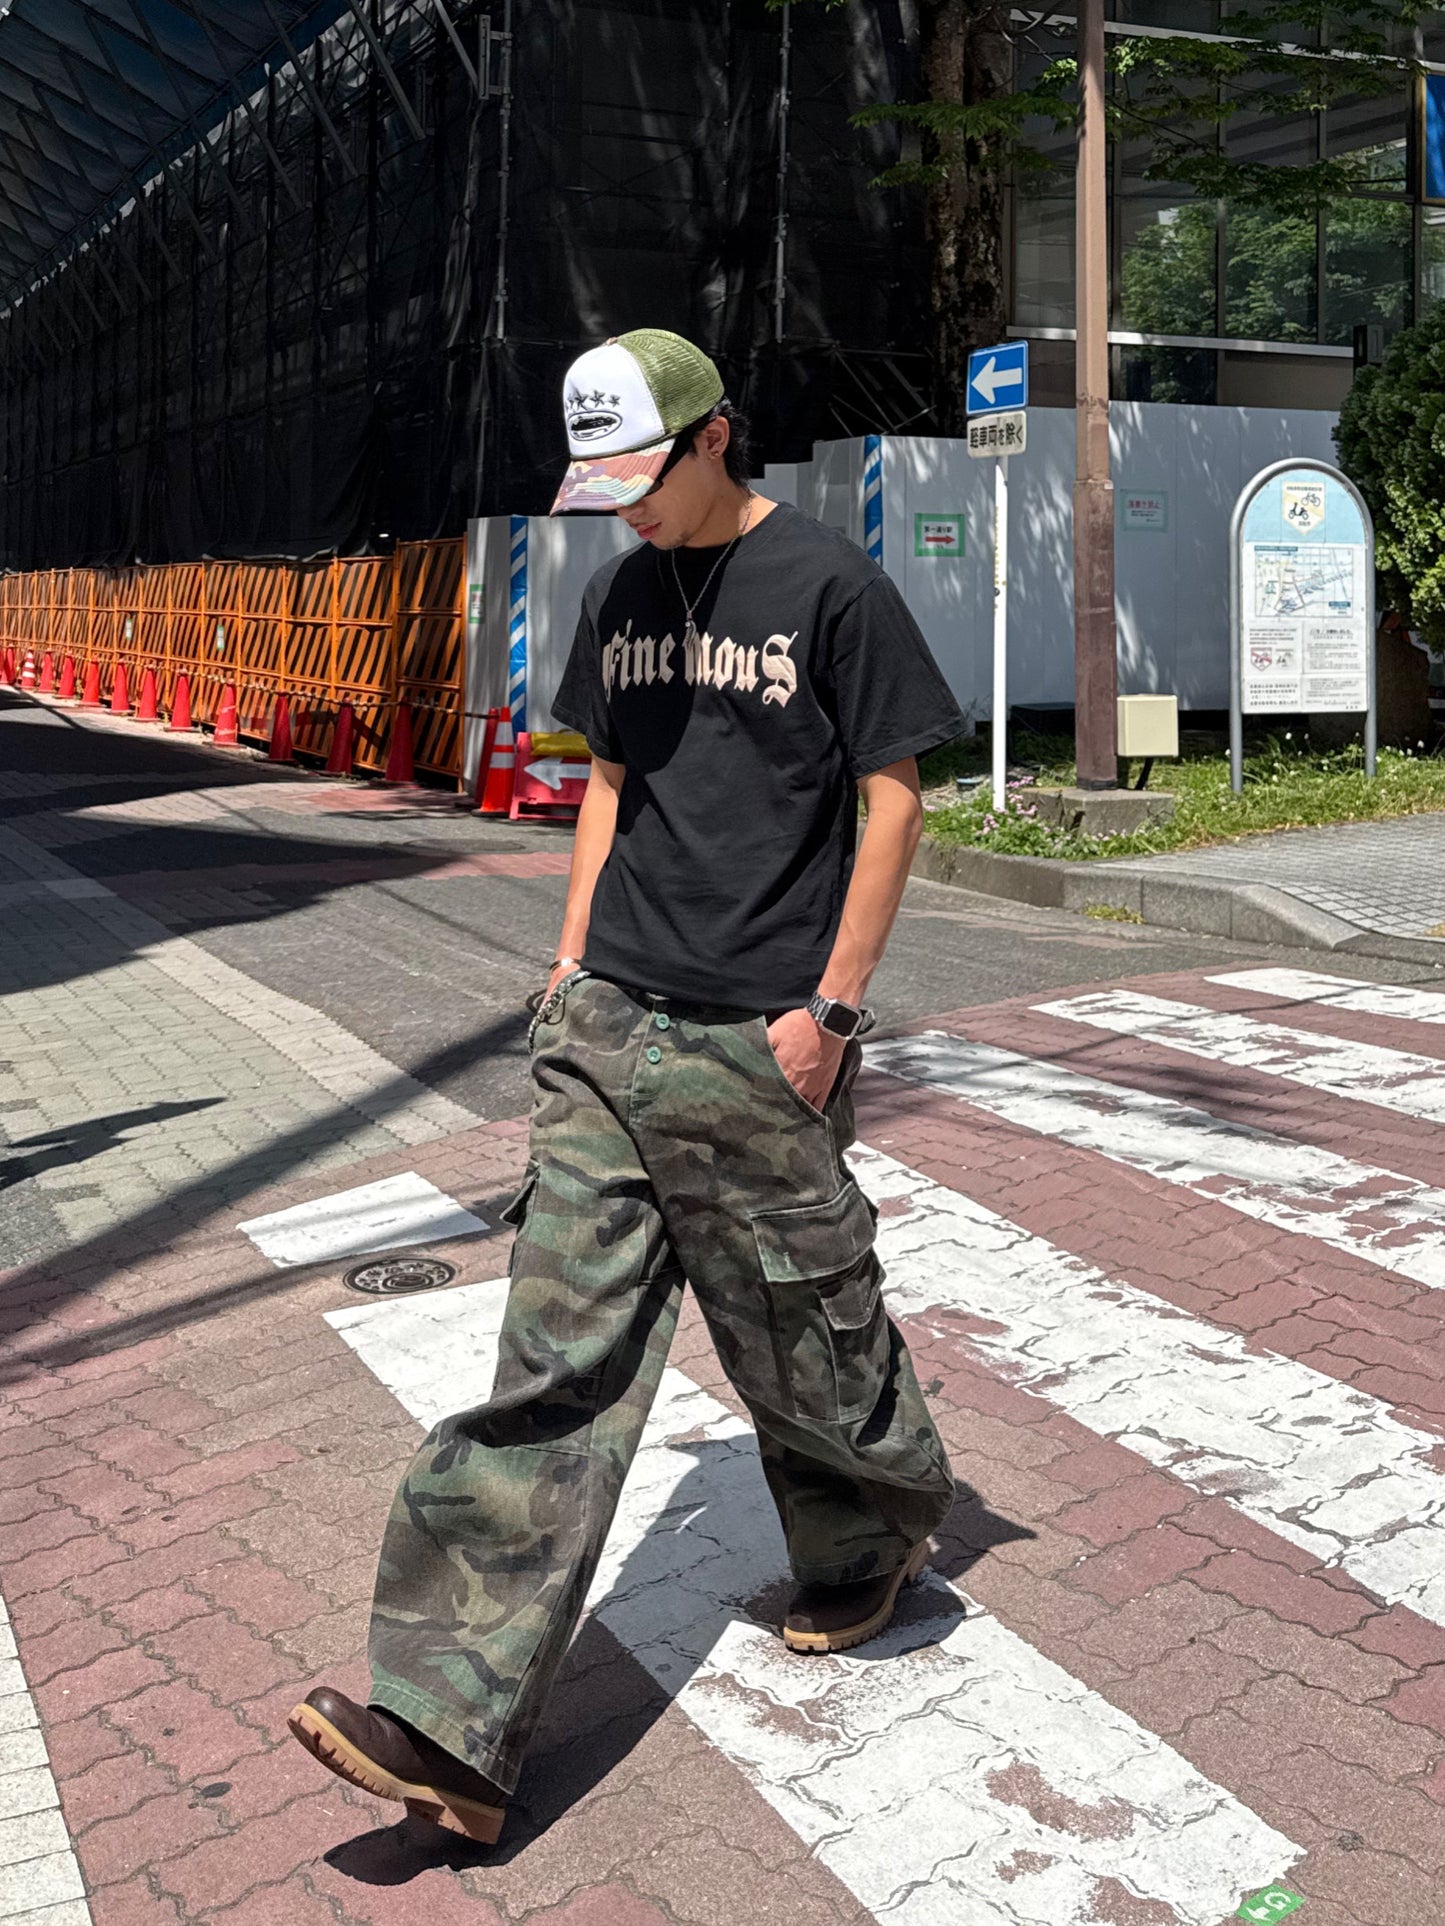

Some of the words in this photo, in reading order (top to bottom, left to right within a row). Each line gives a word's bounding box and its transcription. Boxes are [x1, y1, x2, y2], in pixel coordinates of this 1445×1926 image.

[970, 422, 1023, 448] 軽車両を除く
